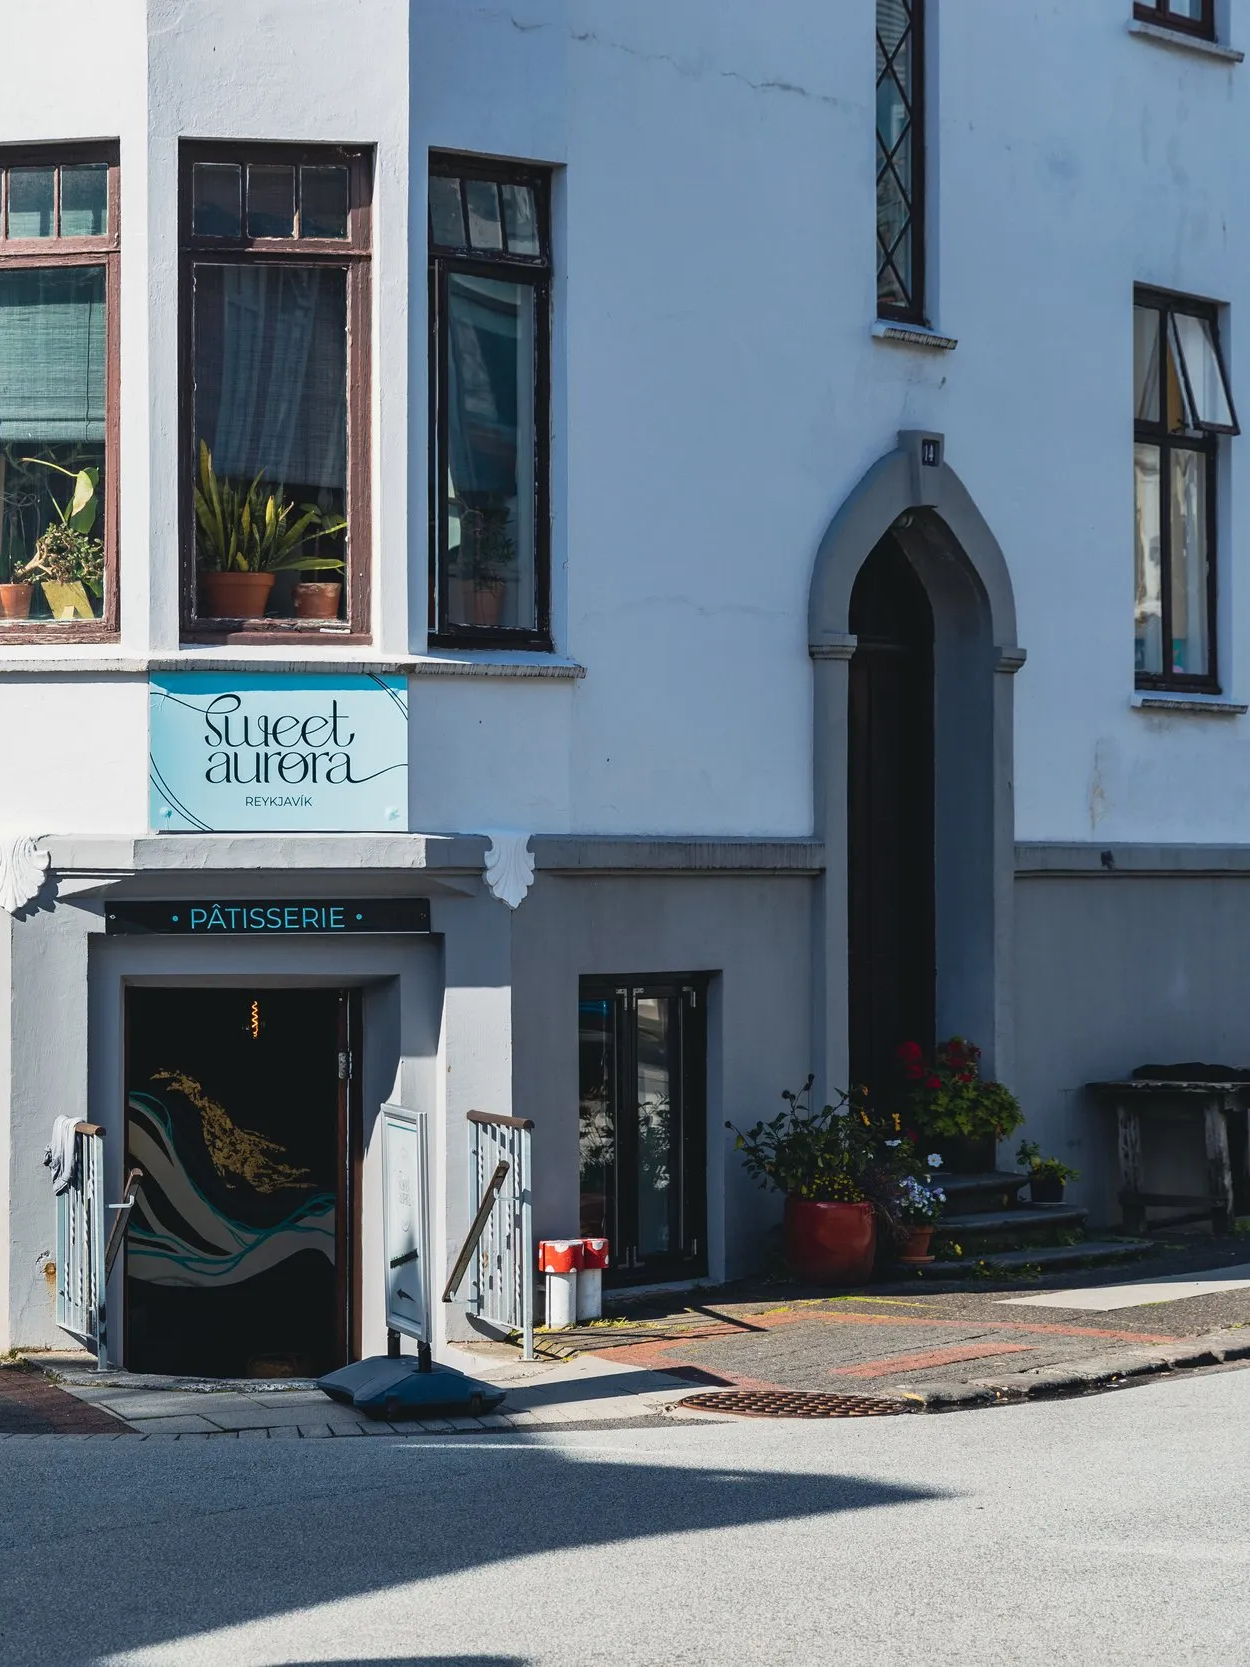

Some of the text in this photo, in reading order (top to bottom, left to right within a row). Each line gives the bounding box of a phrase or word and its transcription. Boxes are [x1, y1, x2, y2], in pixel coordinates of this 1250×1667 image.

[205, 751, 362, 784] aurora
[245, 793, 313, 807] REYKJAVÍK
[190, 903, 346, 929] PÂTISSERIE
